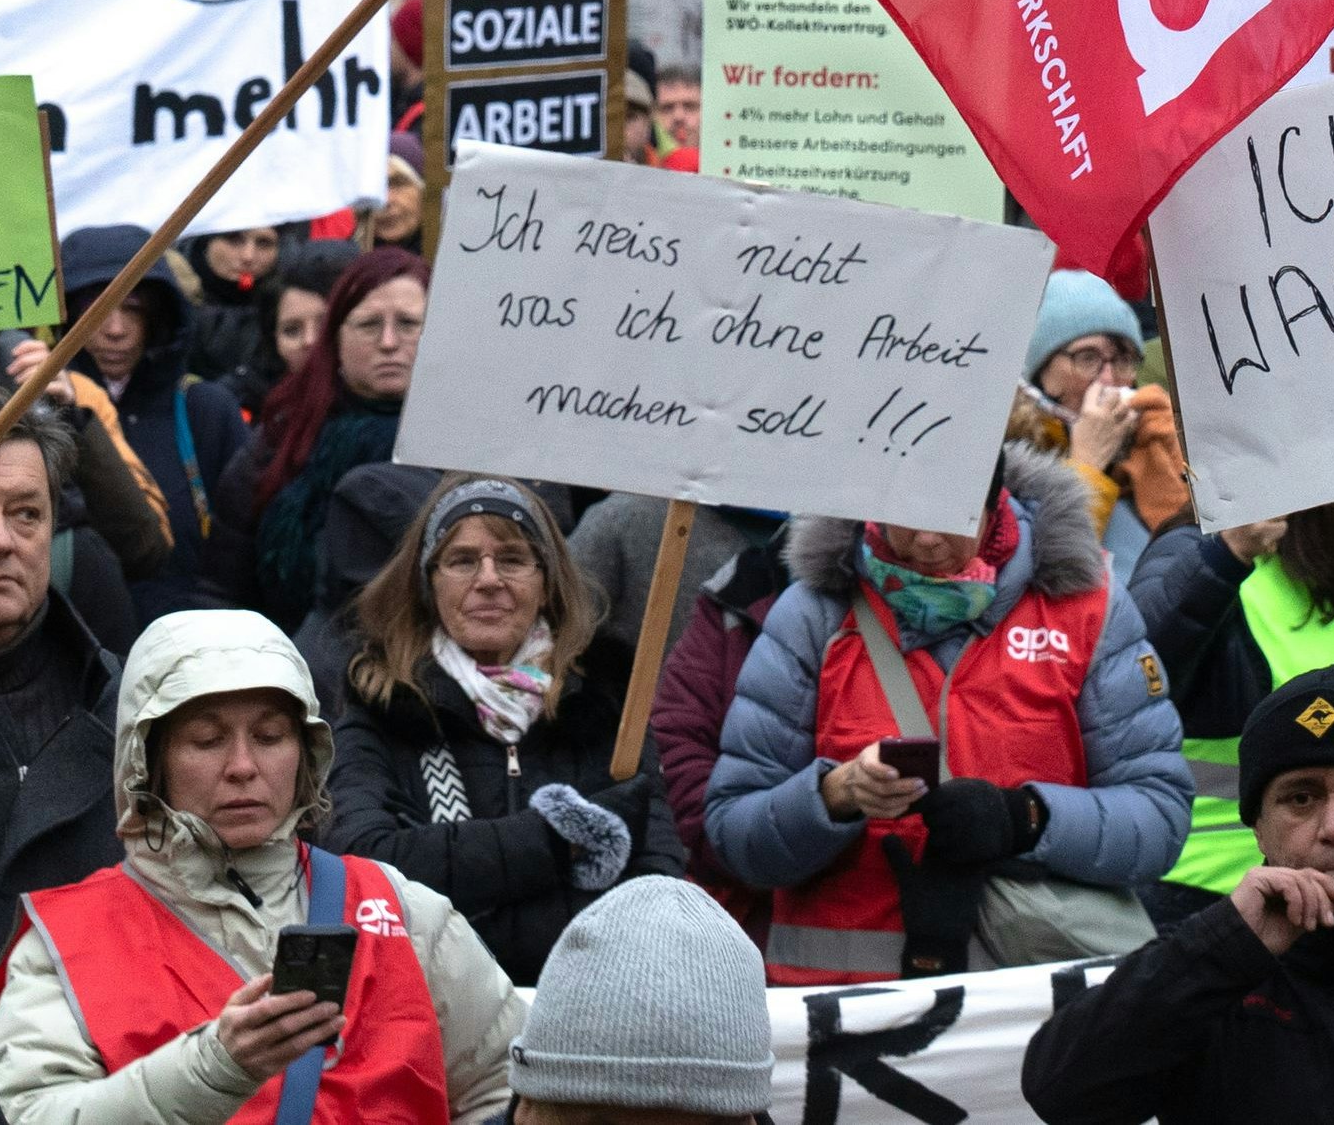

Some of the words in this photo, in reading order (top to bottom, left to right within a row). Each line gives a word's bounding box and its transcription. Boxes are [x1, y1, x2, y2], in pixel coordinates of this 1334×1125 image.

[450, 1, 603, 54] SOZIALE
[132, 0, 381, 146] mehr
[722, 64, 765, 87] Wir
[773, 65, 880, 90] fordern:
[451, 92, 601, 145] ARBEIT
[459, 183, 543, 253] Ich
[576, 218, 682, 269] weiss
[737, 234, 868, 286] nicht
[498, 291, 578, 330] was
[615, 288, 683, 344] ich
[711, 292, 825, 360] ohne
[857, 313, 990, 370] Arbeit
[526, 382, 698, 428] machen
[737, 393, 826, 441] soll
[1006, 625, 1071, 664] gpa
